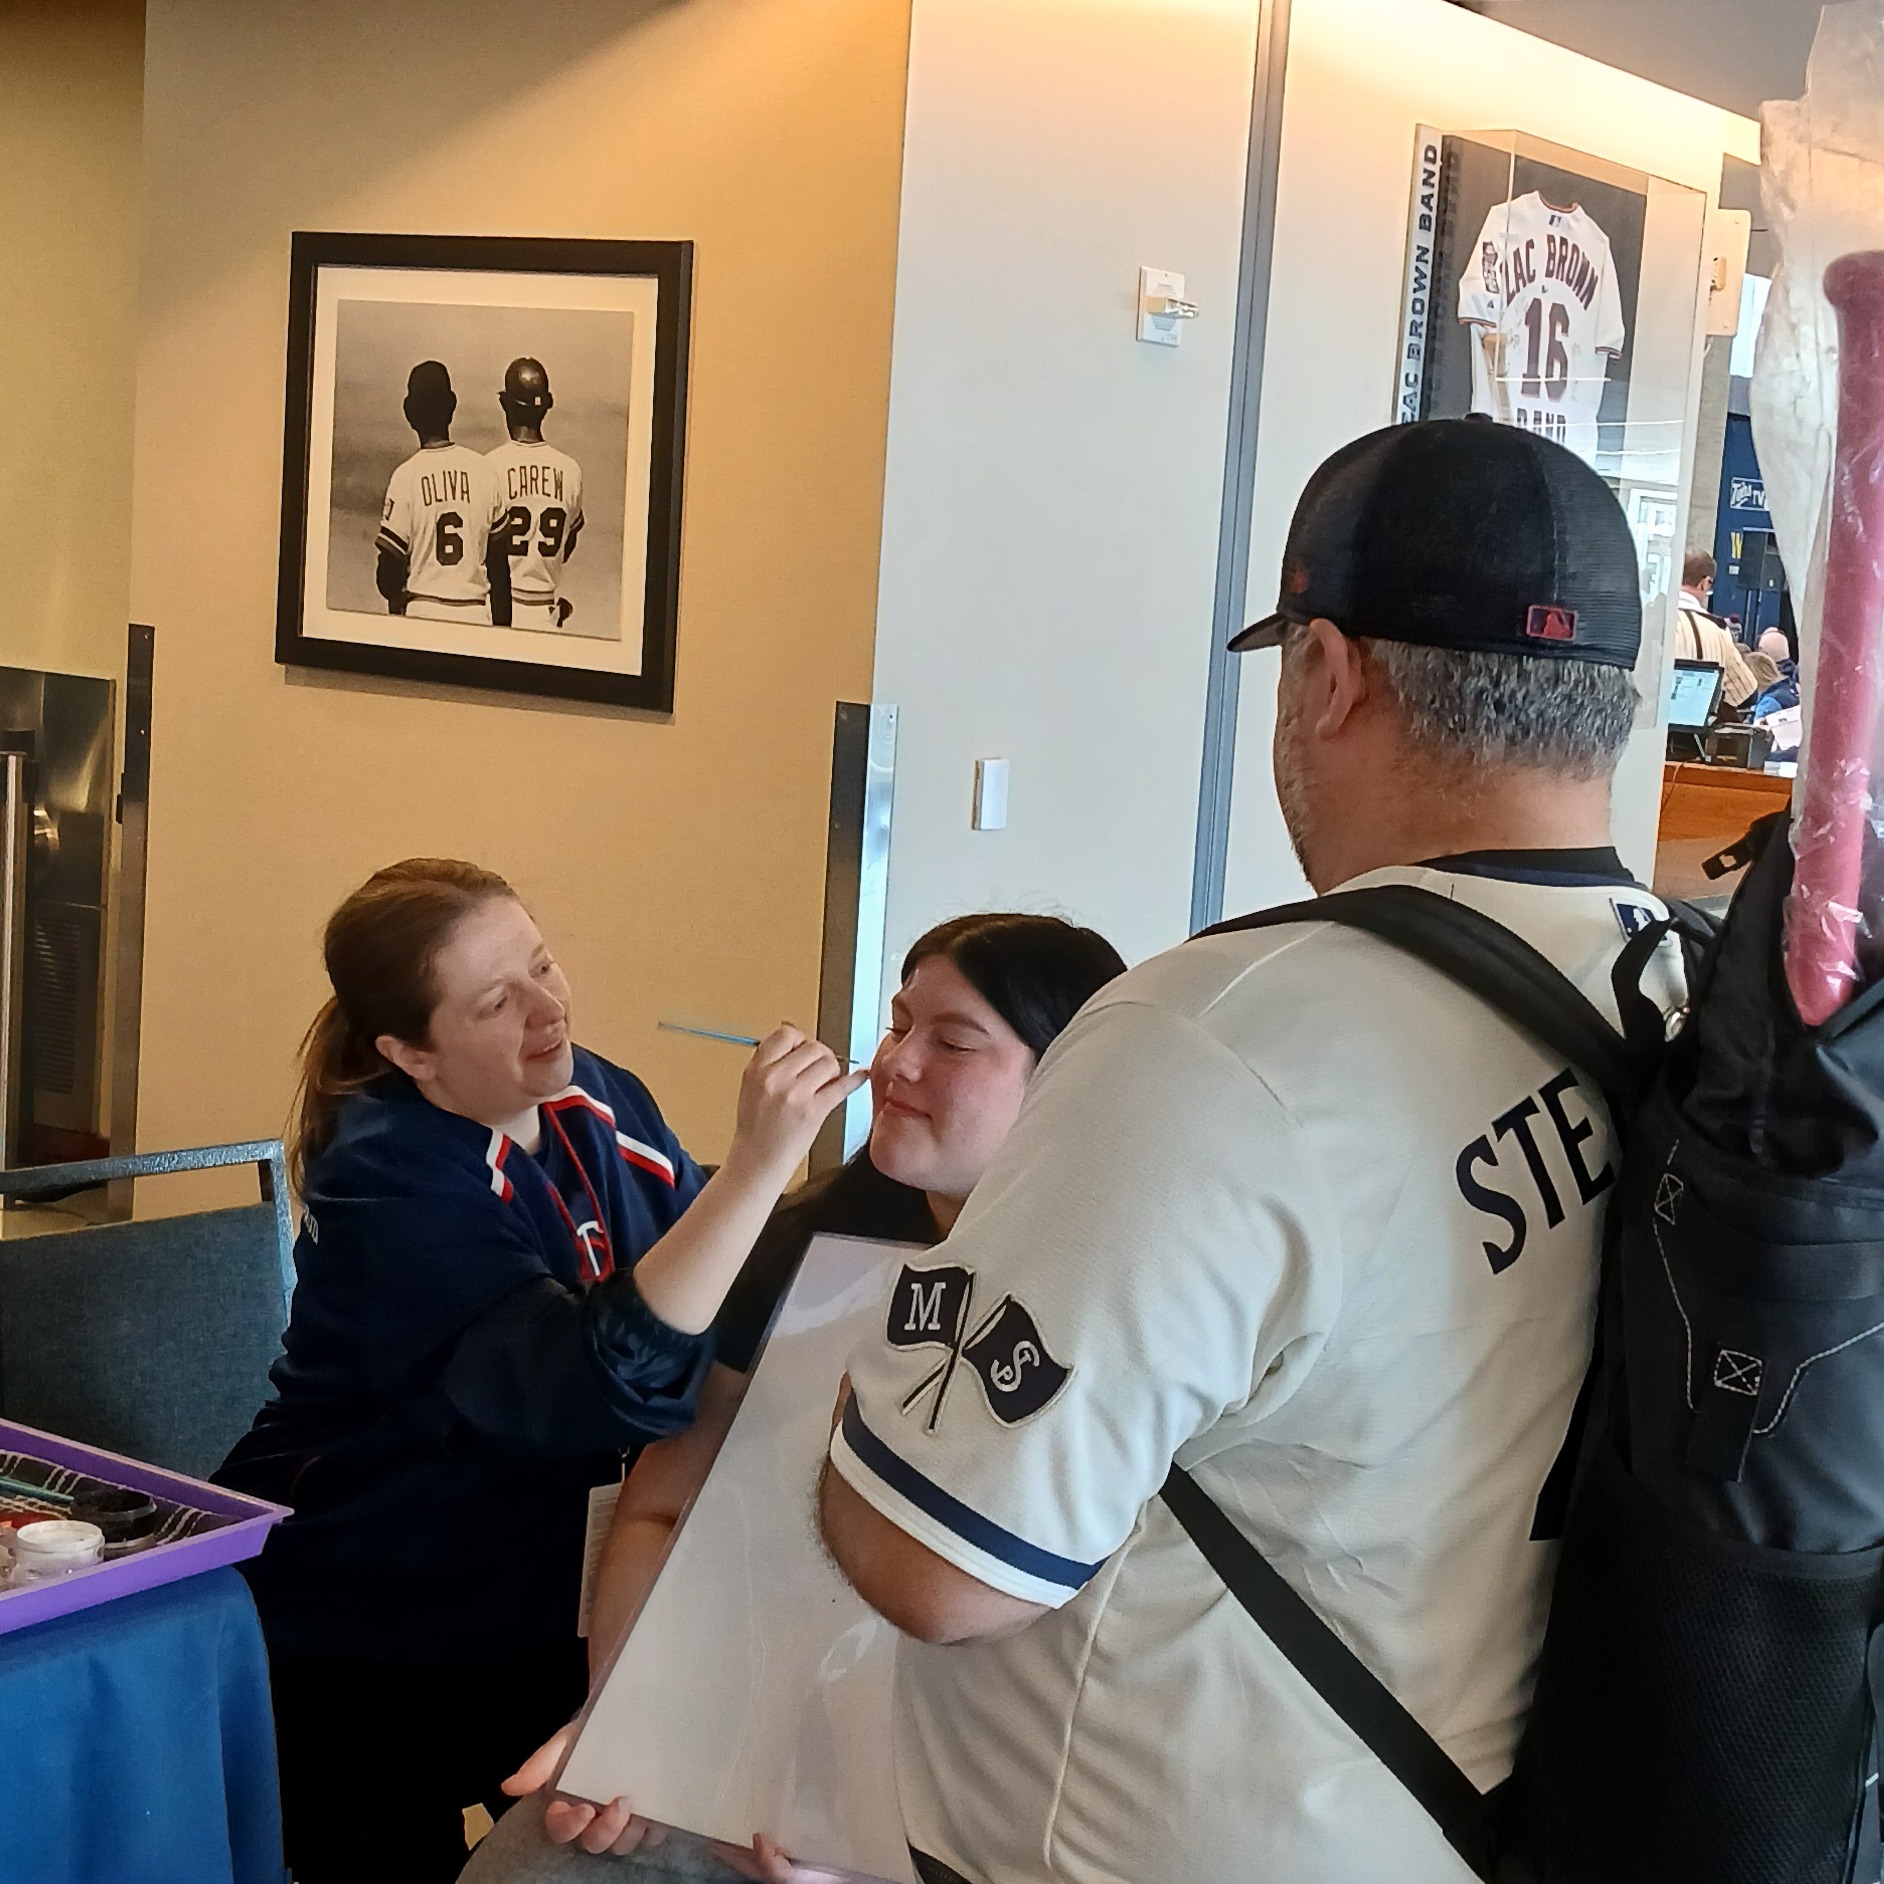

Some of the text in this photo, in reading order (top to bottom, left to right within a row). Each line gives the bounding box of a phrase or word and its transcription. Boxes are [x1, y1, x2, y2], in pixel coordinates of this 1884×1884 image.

[1418, 144, 1438, 232] BAND
[1407, 244, 1431, 362] BROWN
[1545, 233, 1598, 311] BROWN
[1520, 297, 1570, 404] 16
[420, 465, 564, 507] OLIVA CAREW
[435, 505, 567, 566] 6 29
[904, 1281, 947, 1331] M
